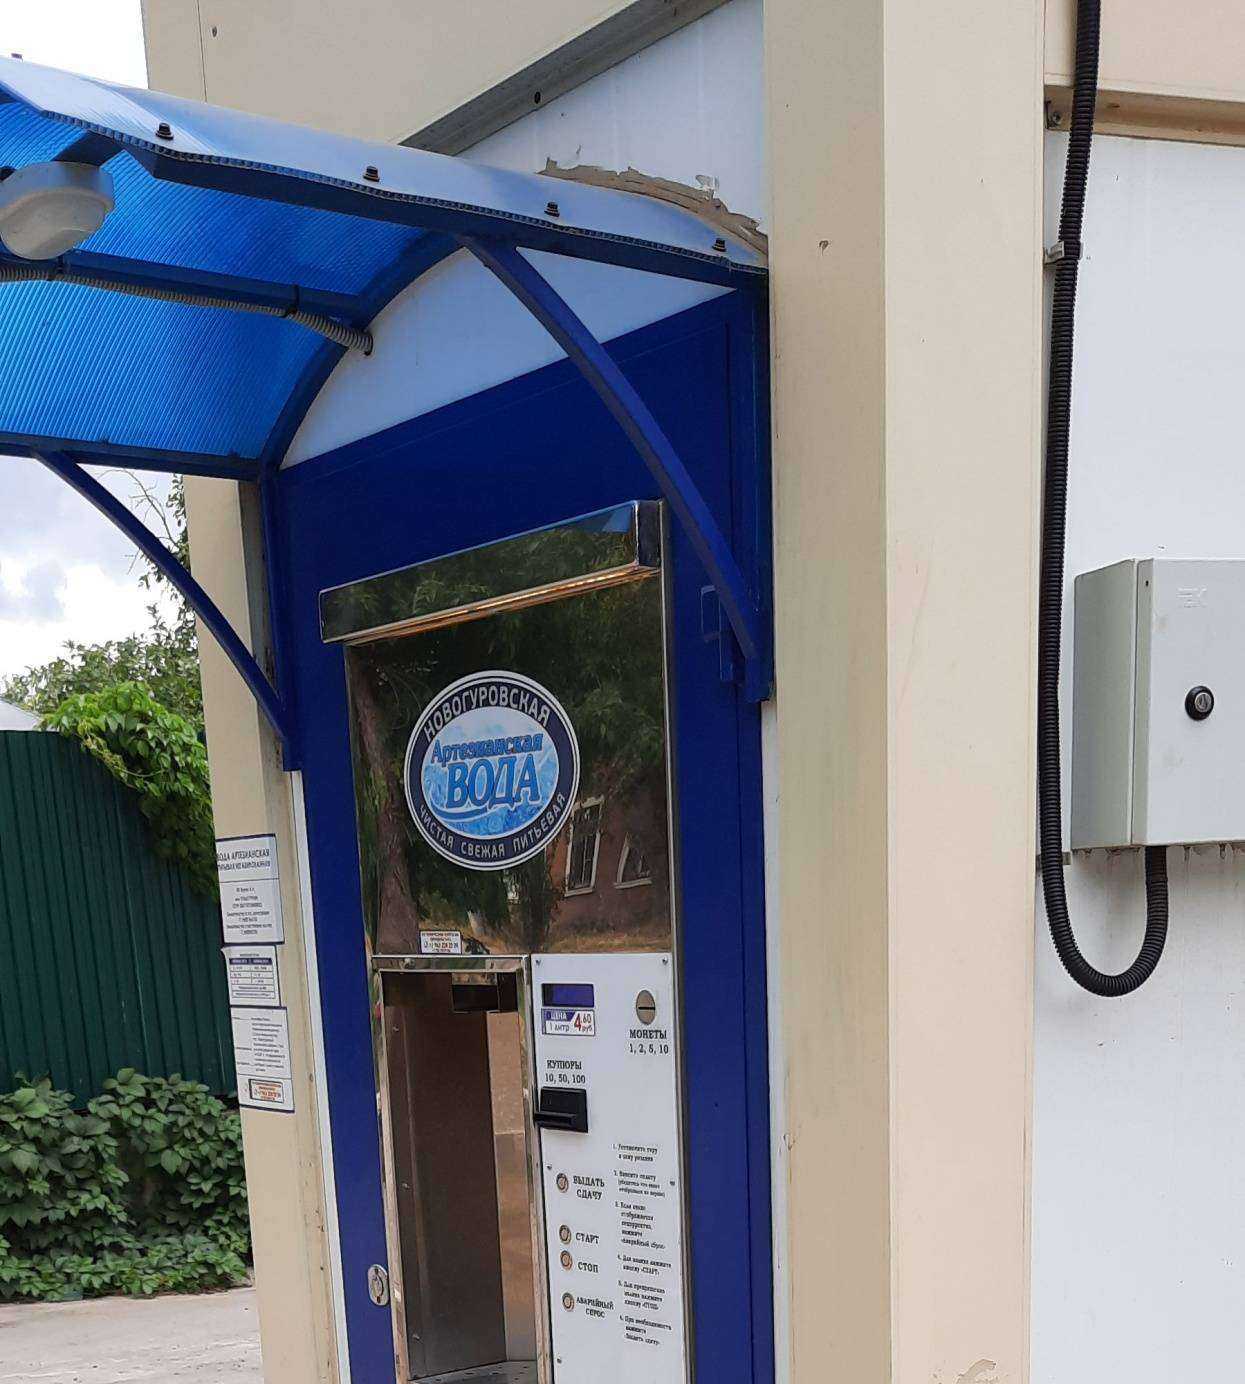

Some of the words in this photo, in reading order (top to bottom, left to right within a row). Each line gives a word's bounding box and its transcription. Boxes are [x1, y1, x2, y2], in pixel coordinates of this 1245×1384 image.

[424, 686, 551, 741] НОВОГУРОВСКАЯ
[431, 733, 544, 767] Артезианская
[446, 754, 541, 809] ВОДА
[419, 805, 453, 848] ЧИСТАЯ
[513, 793, 566, 852] ПИТЬЕВАЯ
[460, 841, 505, 858] СВЕЖАЯ
[629, 1030, 667, 1040] МОНЕТЫ
[659, 1045, 669, 1054] 10
[547, 1060, 582, 1070] КУПЮРЫ
[572, 1074, 586, 1084] 100
[573, 1175, 605, 1188] ВЫДАТЬ
[576, 1189, 603, 1200] СДАЧУ
[575, 1232, 600, 1245] СТАРТ
[577, 1261, 599, 1274] СТОП
[576, 1296, 614, 1310] АВАРИЙНЫЙ
[585, 1308, 606, 1319] СБРОС
